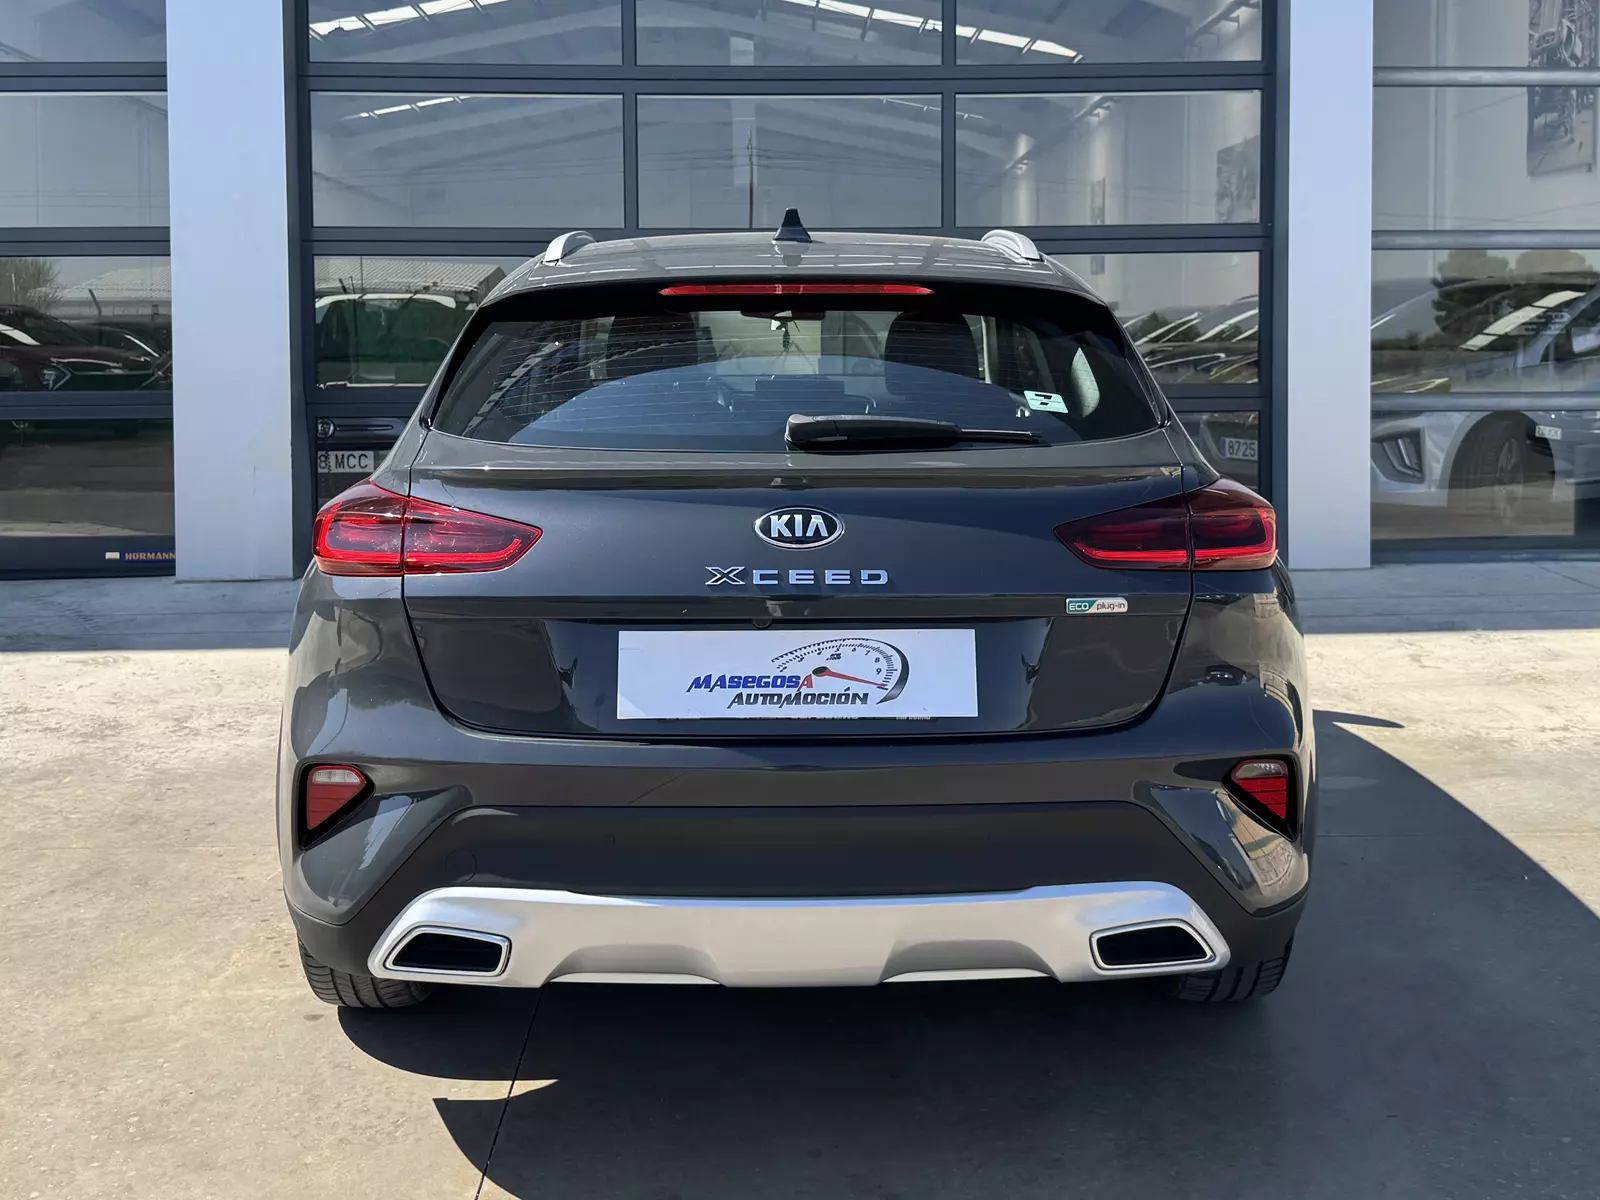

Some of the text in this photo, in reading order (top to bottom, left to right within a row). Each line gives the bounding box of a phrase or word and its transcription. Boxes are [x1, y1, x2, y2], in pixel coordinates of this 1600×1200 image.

[1228, 440, 1256, 457] 8725
[334, 453, 368, 470] MCC
[769, 514, 829, 538] KIA
[705, 566, 889, 586] XCEED
[1069, 602, 1126, 611] ECO plug-in
[727, 686, 869, 709] AUTOMOCIÓN
